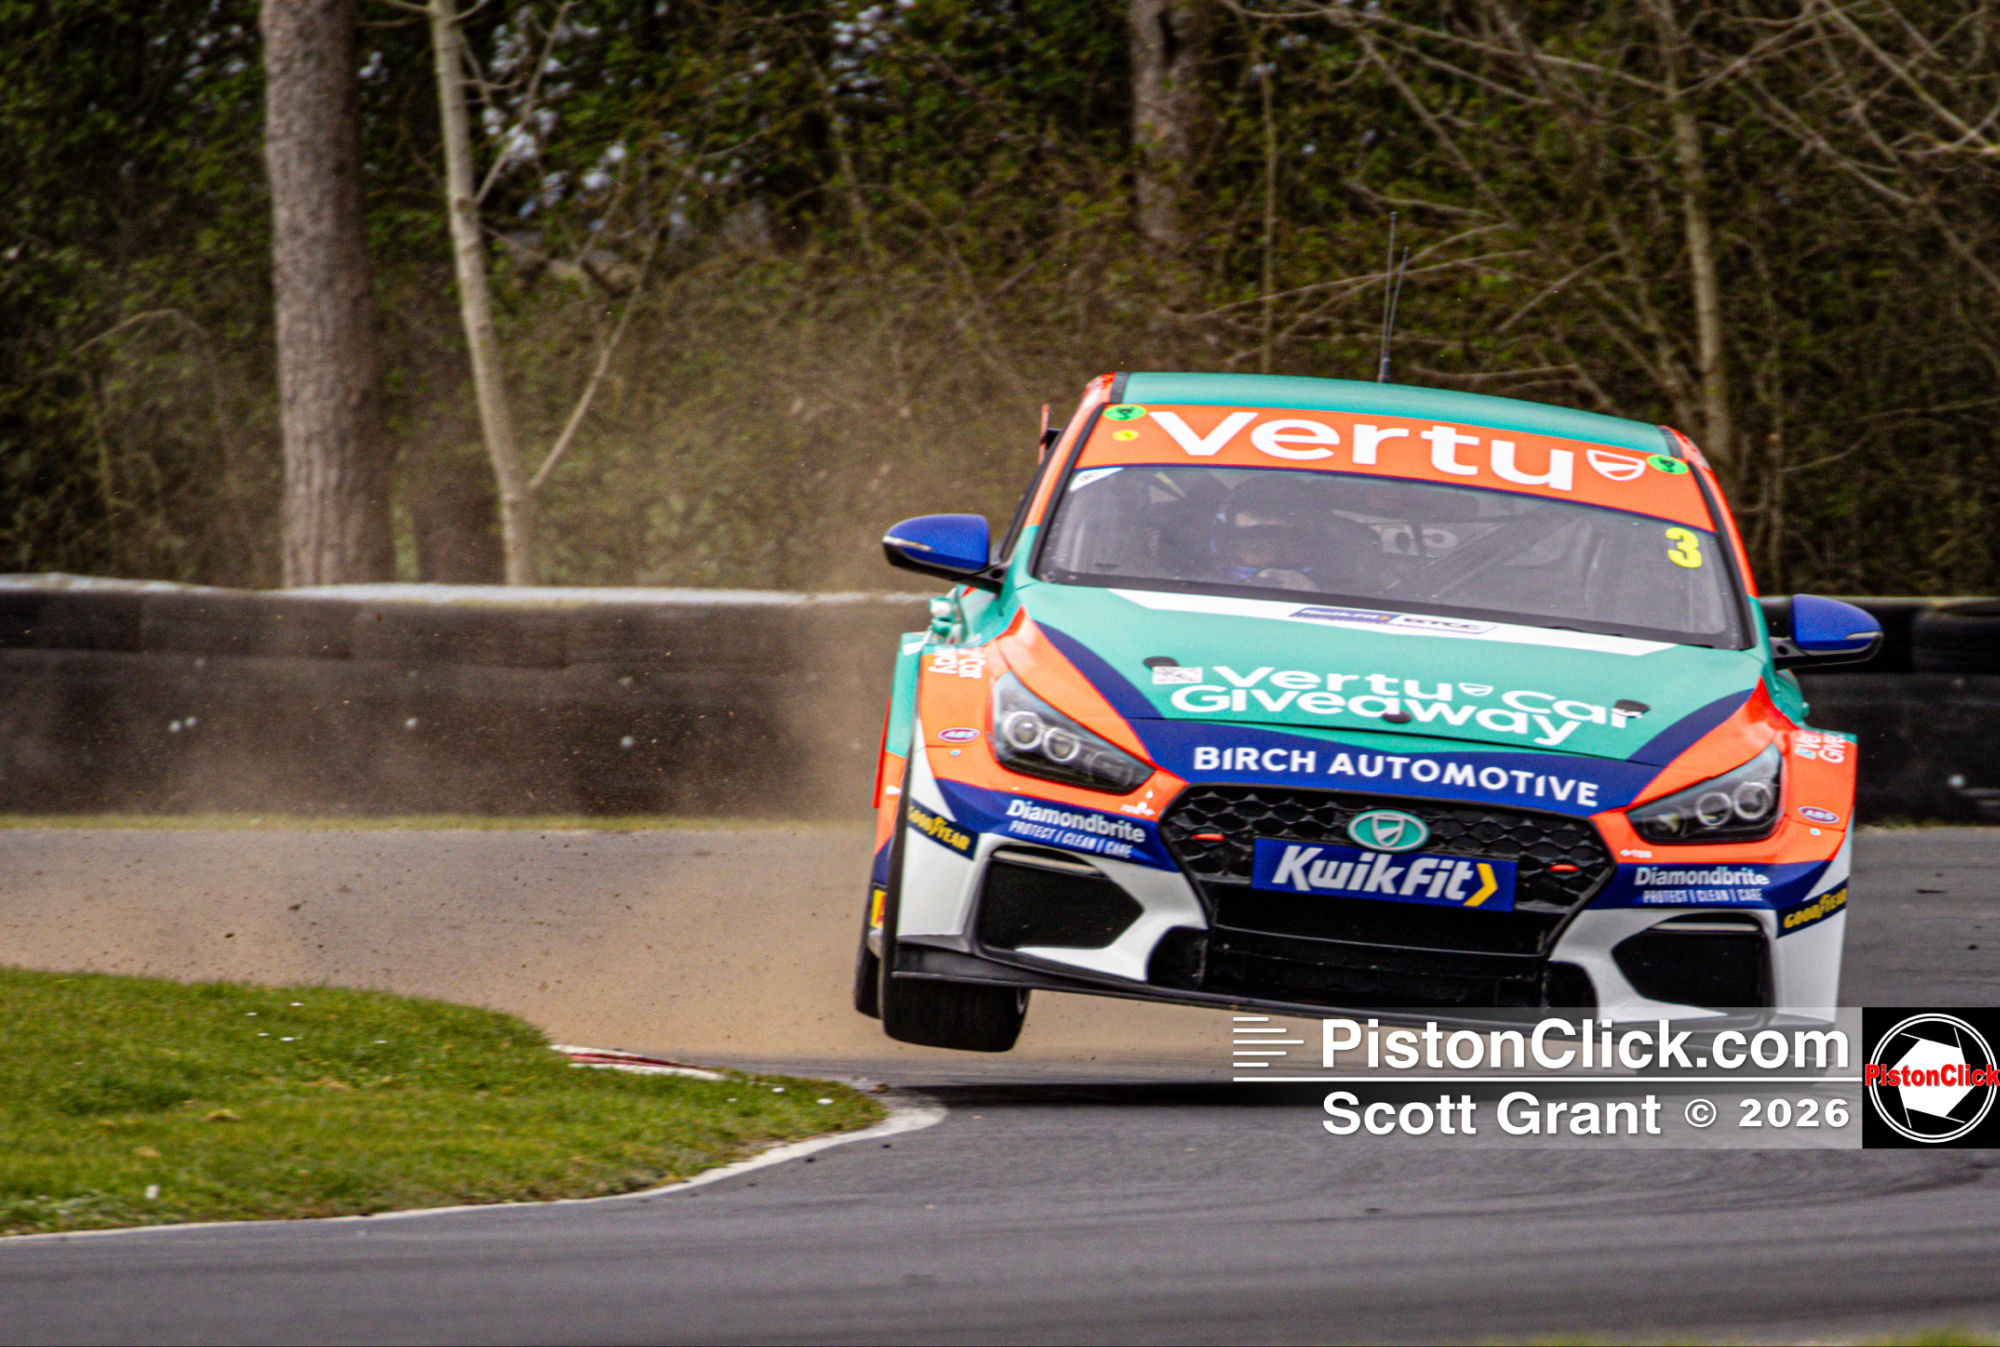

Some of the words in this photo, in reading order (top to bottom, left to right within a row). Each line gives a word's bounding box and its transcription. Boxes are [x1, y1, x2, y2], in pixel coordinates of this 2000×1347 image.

[1148, 411, 1574, 492] Vertu
[1665, 527, 1702, 568] 3
[1170, 684, 1583, 747] Giveaway
[1212, 665, 1453, 701] Vertu
[1501, 689, 1644, 729] Car
[1193, 746, 1317, 773] BIRCH
[1327, 752, 1600, 807] AUTOMOTIVE
[1006, 799, 1147, 843] Diamondbrite
[1008, 820, 1055, 840] PROTECT
[1062, 831, 1097, 851] CLEAN
[1634, 866, 1770, 886] Diamondbrite
[1643, 889, 1688, 903] PROTECT
[1699, 889, 1730, 903] CLEAN
